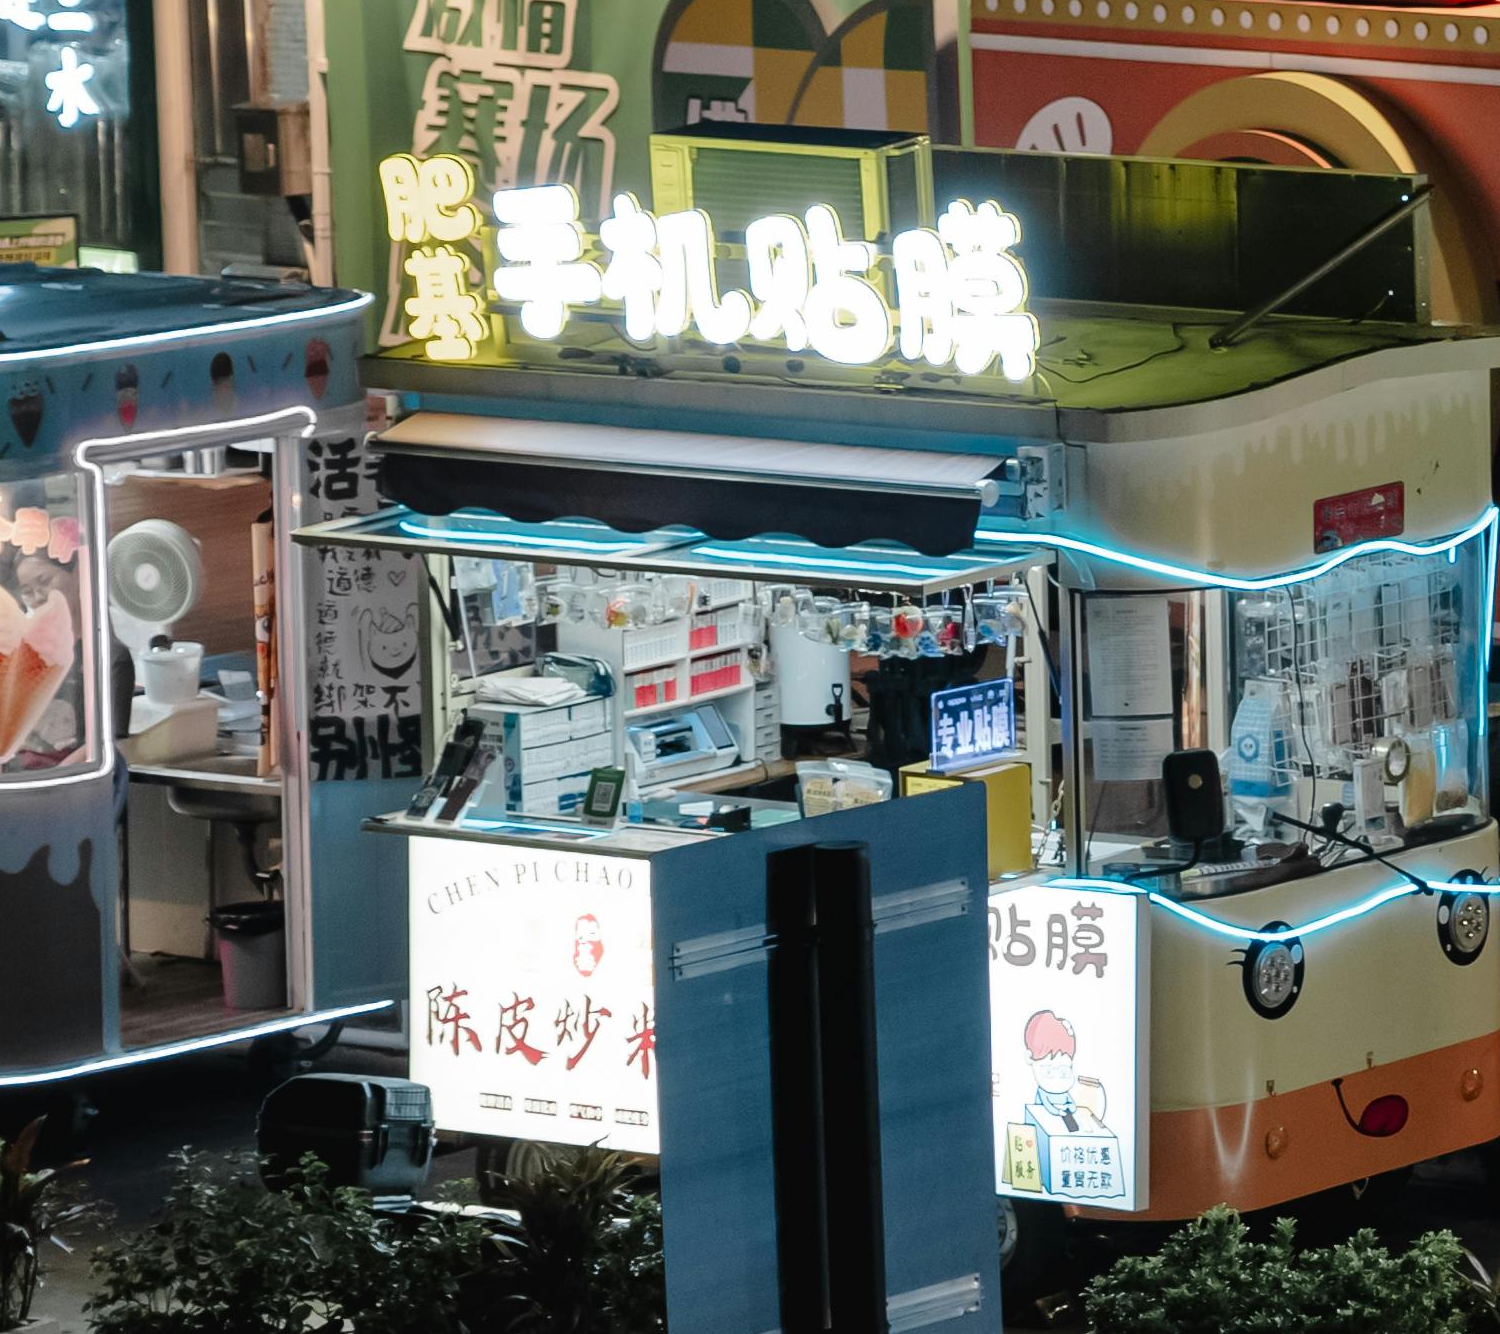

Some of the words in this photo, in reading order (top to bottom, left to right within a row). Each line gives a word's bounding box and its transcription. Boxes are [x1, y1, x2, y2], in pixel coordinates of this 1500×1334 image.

[492, 181, 1040, 382] 手机贴膜
[553, 860, 634, 891] CHAO
[988, 901, 1108, 979] 贴膜
